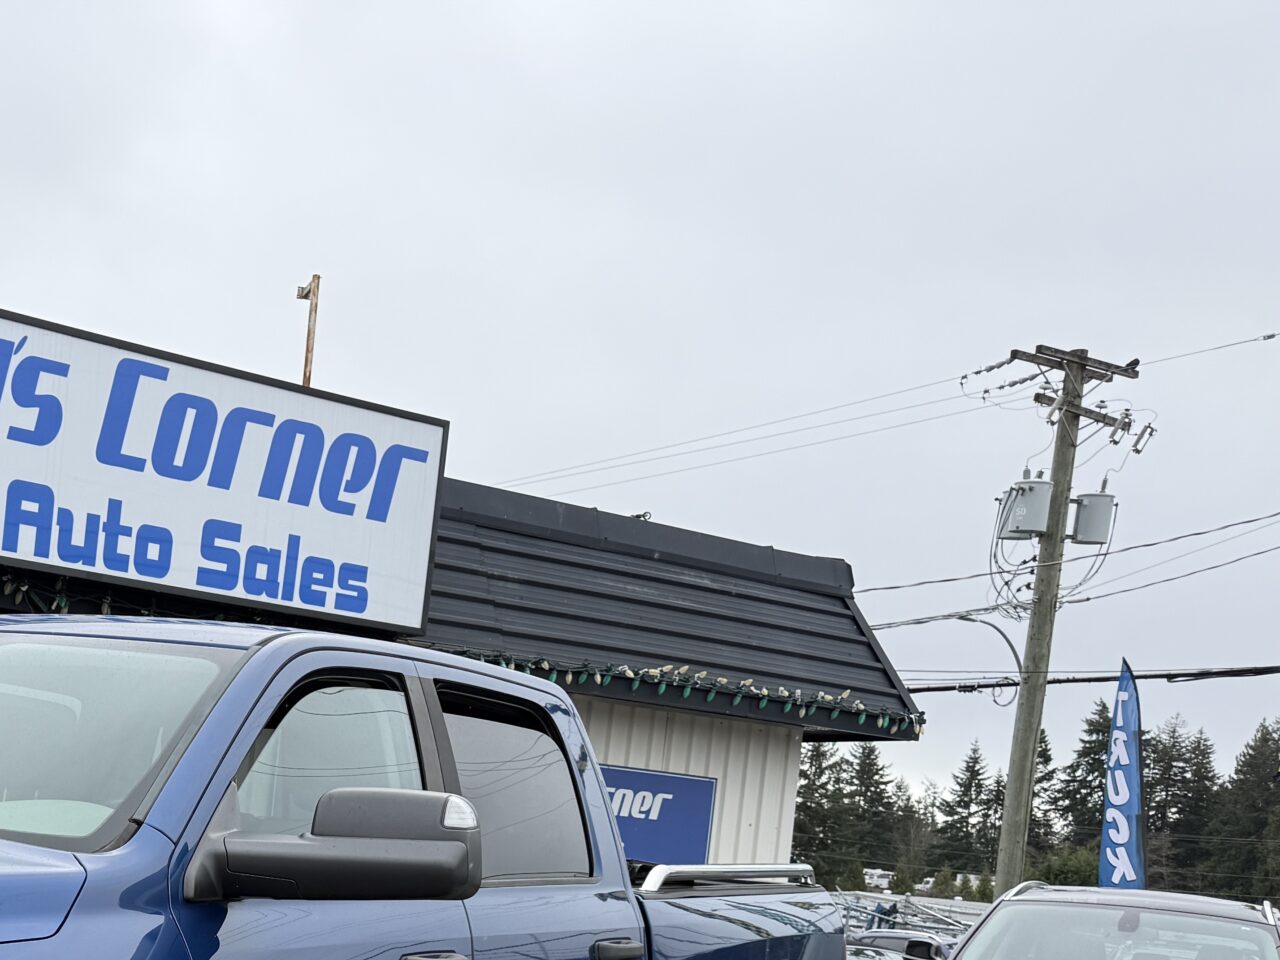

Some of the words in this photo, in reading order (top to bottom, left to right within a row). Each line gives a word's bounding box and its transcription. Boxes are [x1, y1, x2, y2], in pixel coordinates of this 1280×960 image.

[95, 357, 429, 523] Corner
[1, 479, 175, 580] Auto
[196, 519, 370, 615] Sales
